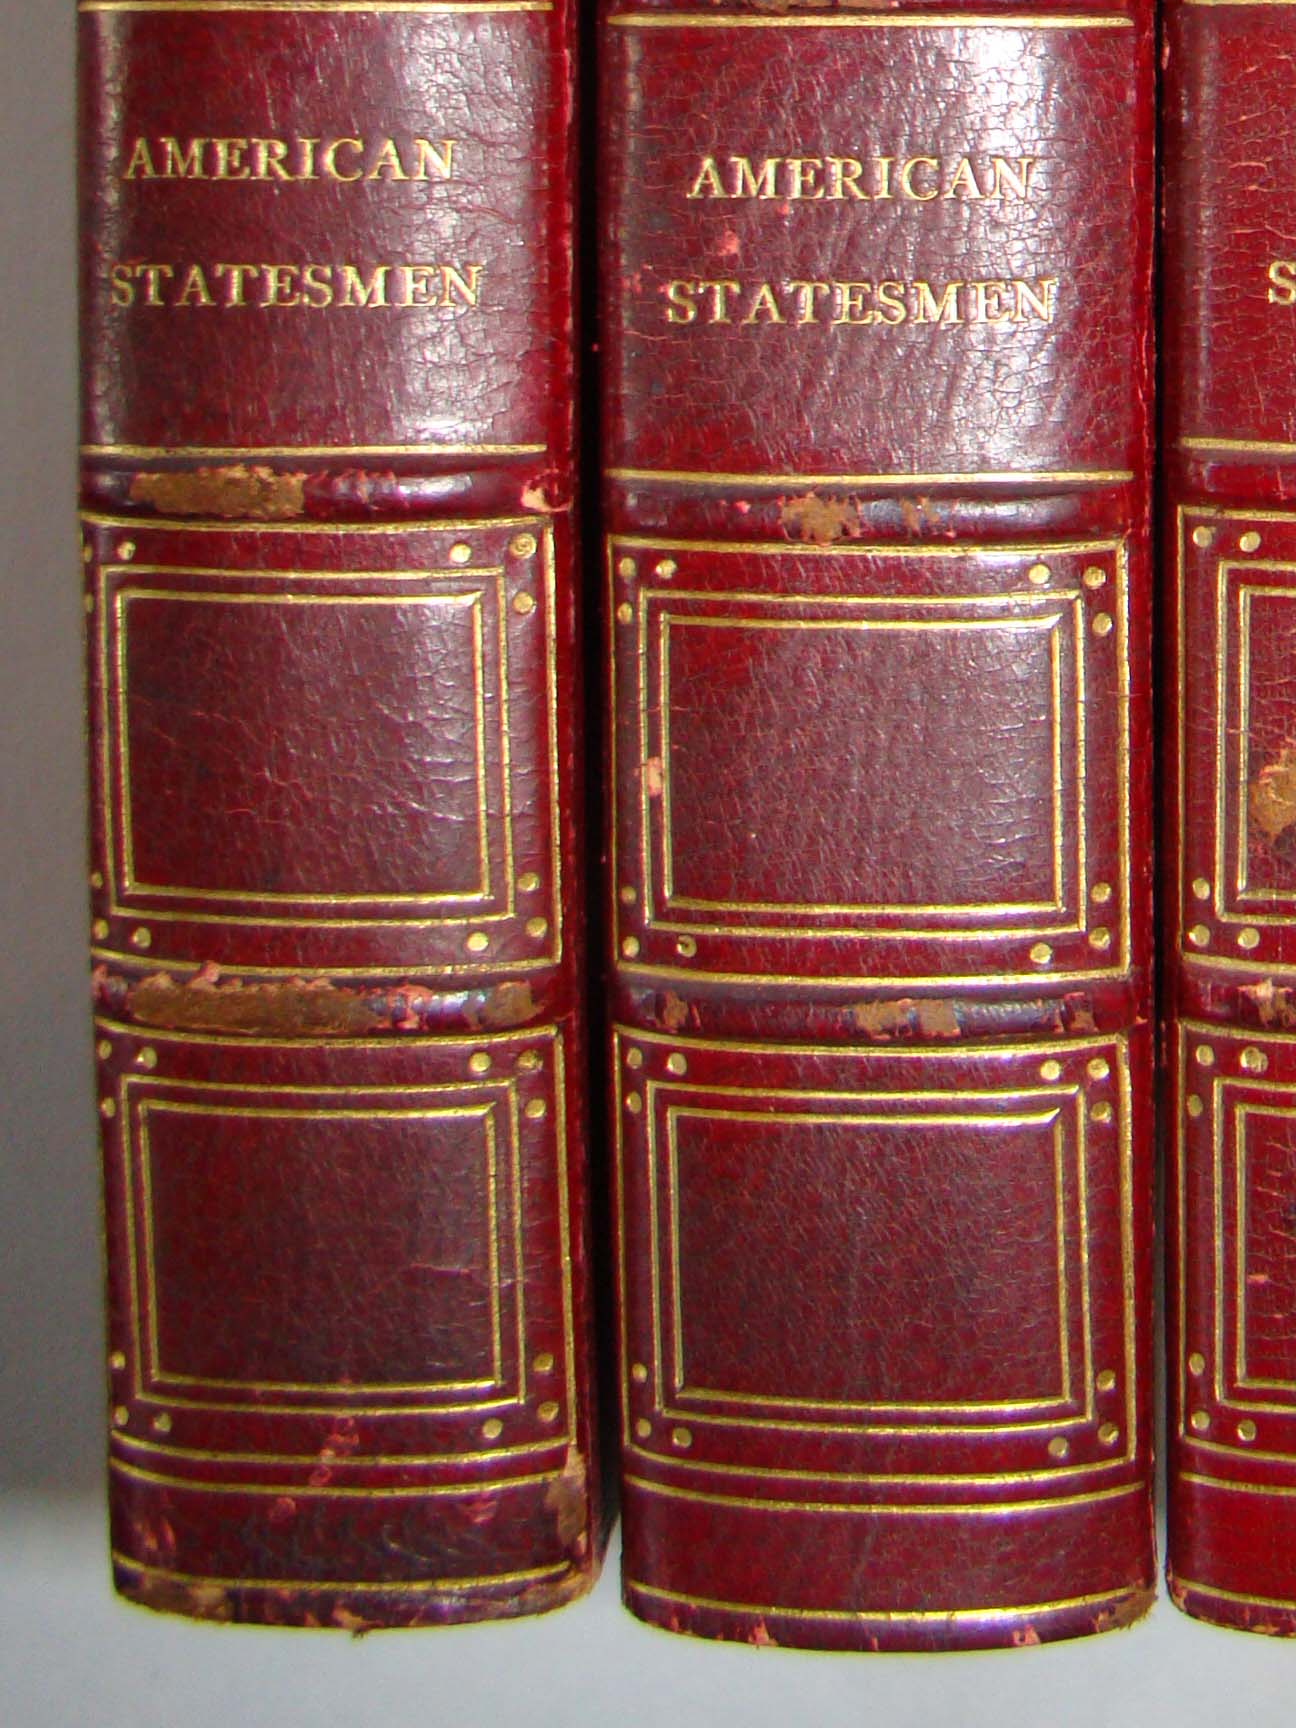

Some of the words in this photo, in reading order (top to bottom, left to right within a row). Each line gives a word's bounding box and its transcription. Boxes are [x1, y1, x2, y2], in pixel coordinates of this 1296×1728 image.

[122, 137, 458, 181] AMERICAN
[686, 155, 1036, 200] AMERICAN
[110, 262, 485, 308] STATESMEN
[667, 277, 1058, 325] STATESMEN
